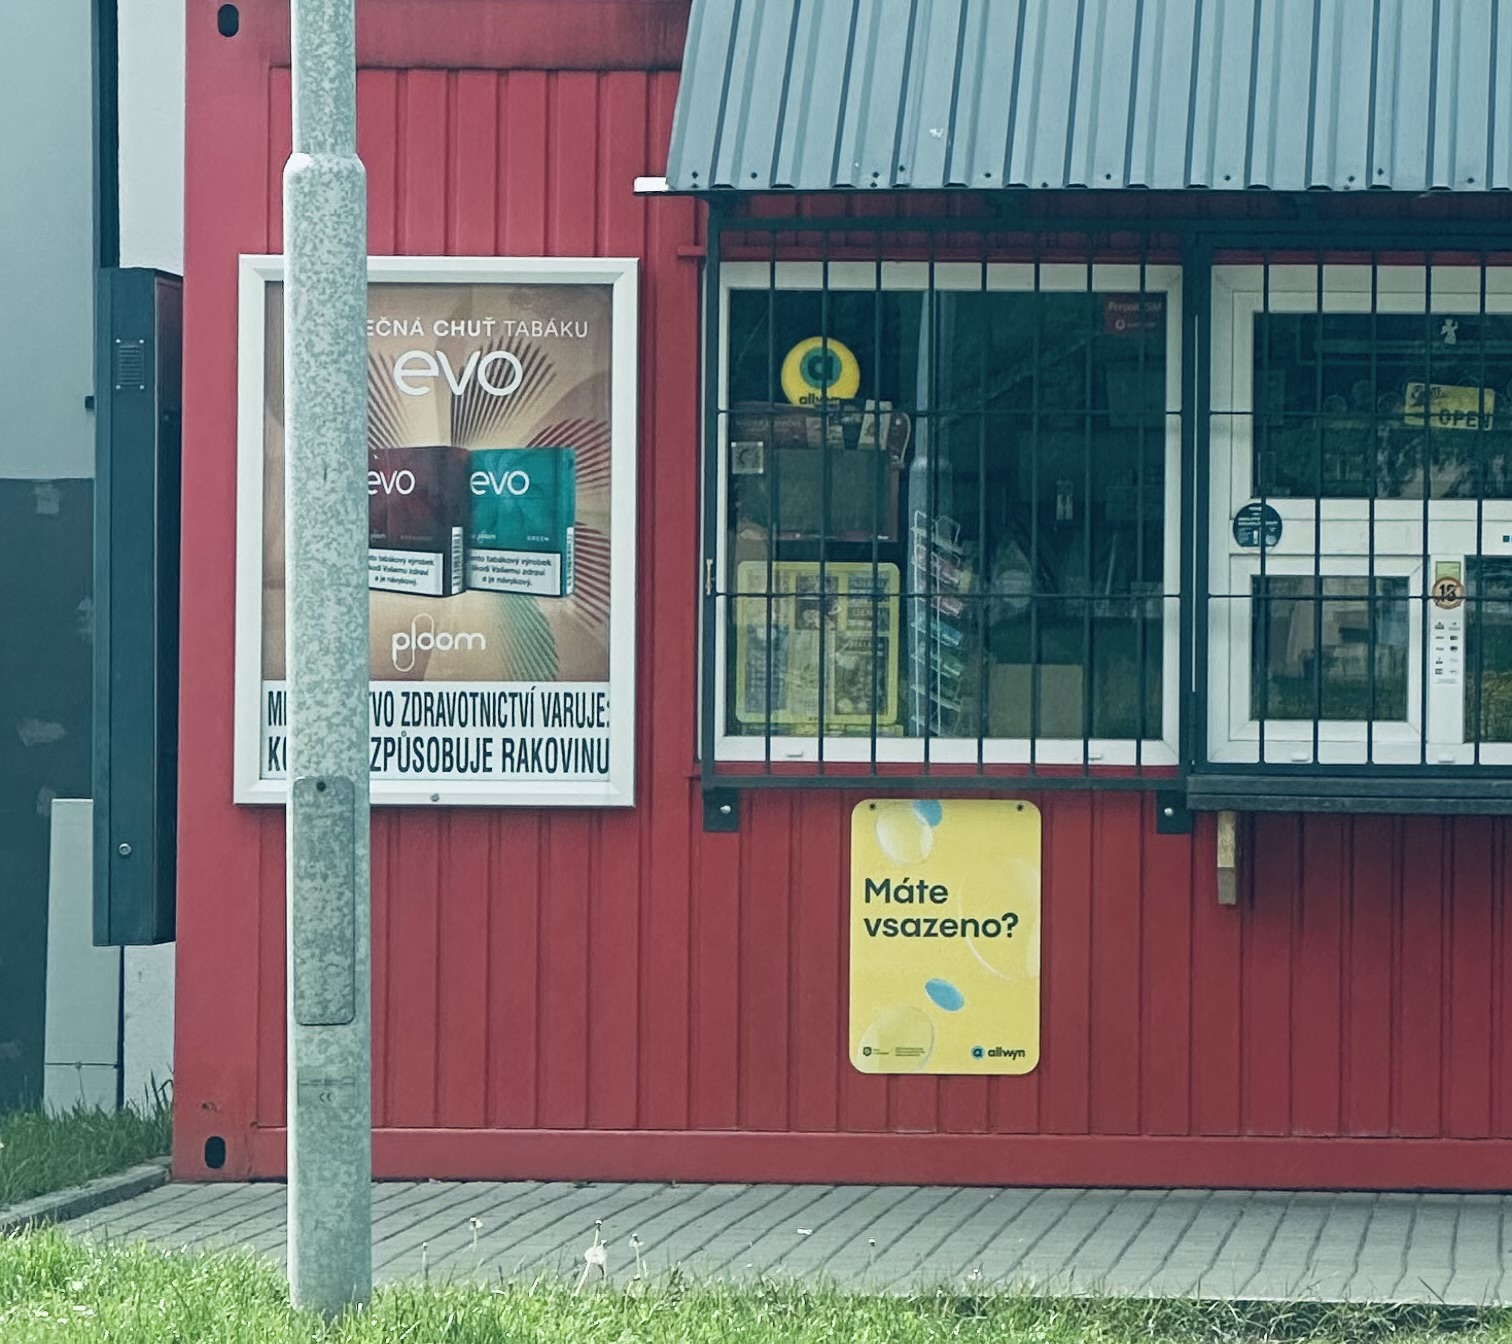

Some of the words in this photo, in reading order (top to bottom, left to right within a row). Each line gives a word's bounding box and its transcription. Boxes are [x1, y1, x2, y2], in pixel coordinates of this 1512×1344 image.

[433, 317, 496, 338] CHUŤ
[504, 318, 589, 338] TABÁKU
[393, 349, 523, 396] evo
[368, 470, 416, 496] evo
[470, 470, 530, 496] evo
[392, 612, 486, 673] ploom
[401, 686, 536, 728] ZDRAVOTNICTVÍ
[370, 730, 494, 774] ZPŮSOBUJE
[501, 737, 610, 774] RAKOVINU
[864, 877, 949, 904] Máte
[863, 912, 1020, 939] vsazeno?
[987, 1046, 1026, 1061] allwyn
